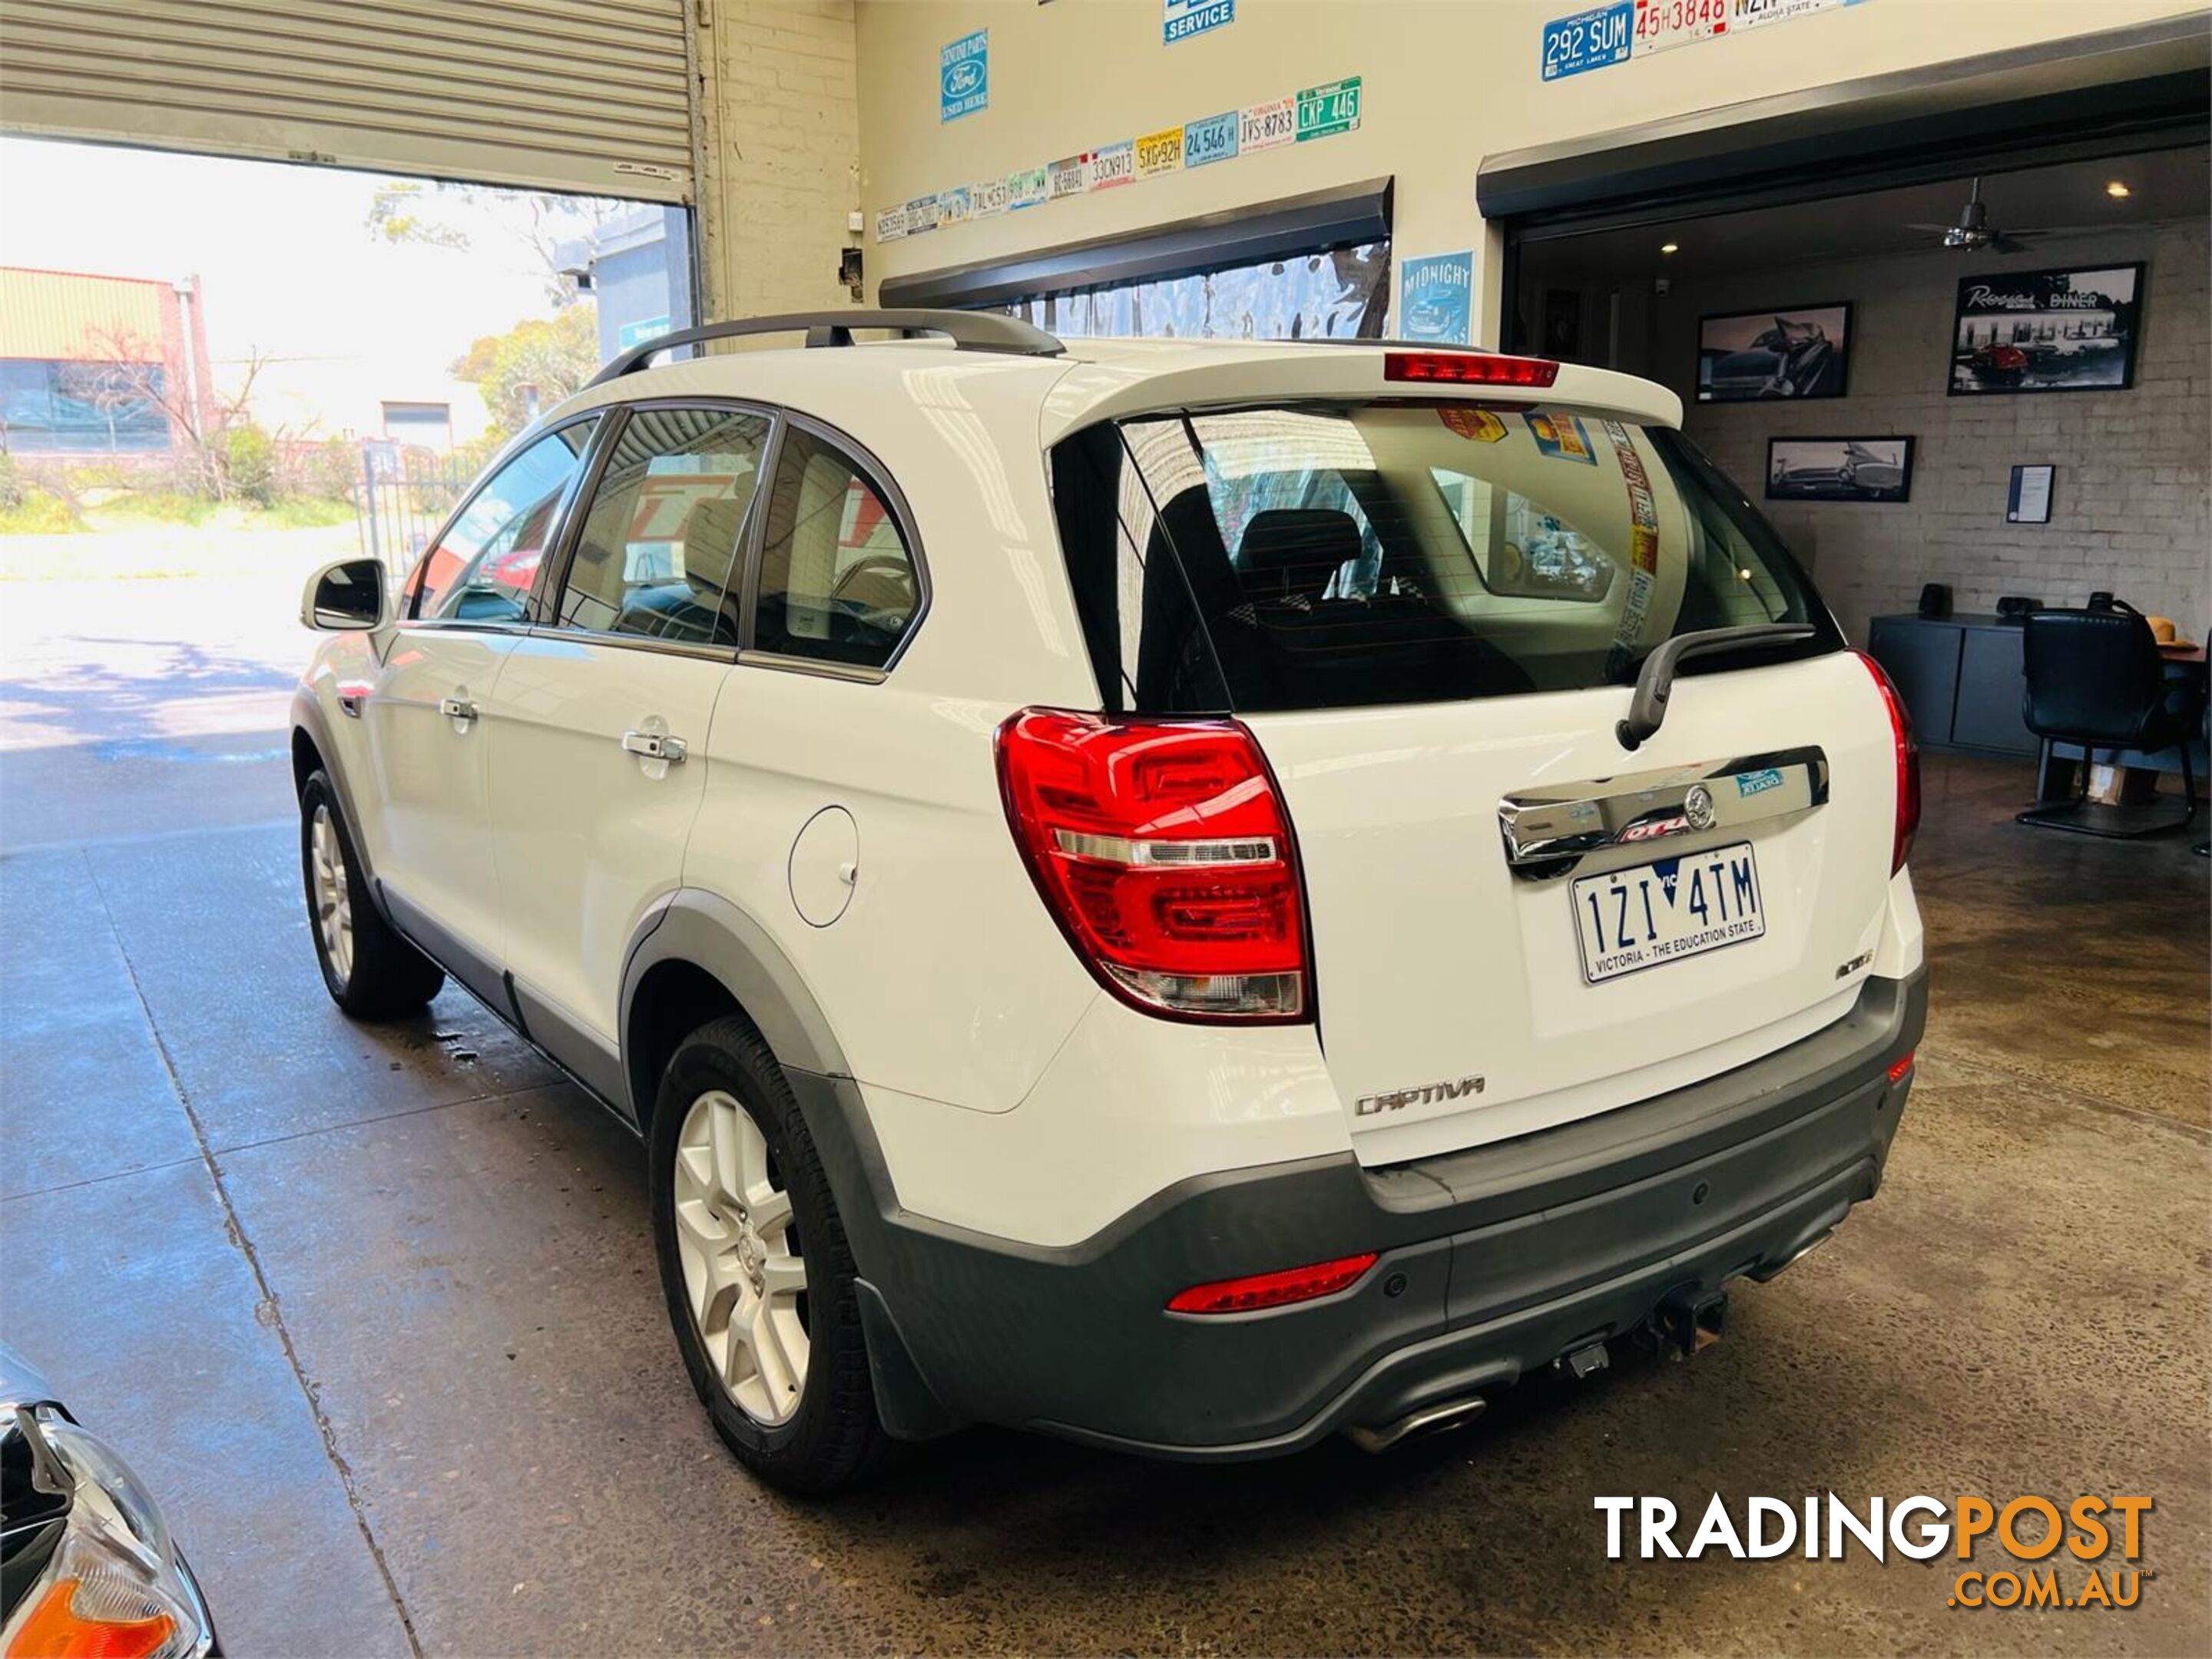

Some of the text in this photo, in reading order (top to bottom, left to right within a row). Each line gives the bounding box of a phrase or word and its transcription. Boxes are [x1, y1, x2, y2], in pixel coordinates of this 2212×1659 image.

[1169, 4, 1229, 38] SERVICE
[1567, 11, 1608, 28] MICHIGAN
[1757, 3, 1810, 20] ALOHA STATE
[1547, 13, 1627, 65] 292 SUM
[1565, 55, 1606, 69] GREAT LAKES
[950, 65, 976, 92] Ford
[964, 92, 986, 111] HERE
[1301, 100, 1324, 128] CKP
[1332, 91, 1355, 120] 446
[1187, 133, 1200, 155] 24
[1204, 125, 1224, 152] 546
[1241, 110, 1293, 143] JVS-8783
[1093, 154, 1132, 181] 33CN913
[1404, 263, 1470, 298] MIDNIGHT
[2050, 293, 2098, 308] DINER
[1661, 874, 1677, 887] VIC
[1588, 857, 1757, 953] 1ZI 4TM
[1595, 950, 1644, 973] VICTORIA
[1652, 942, 1671, 958] THE
[1674, 929, 1727, 952] EDUCATION
[1728, 919, 1755, 938] STATE
[1355, 1075, 1485, 1116] CAPTIVA
